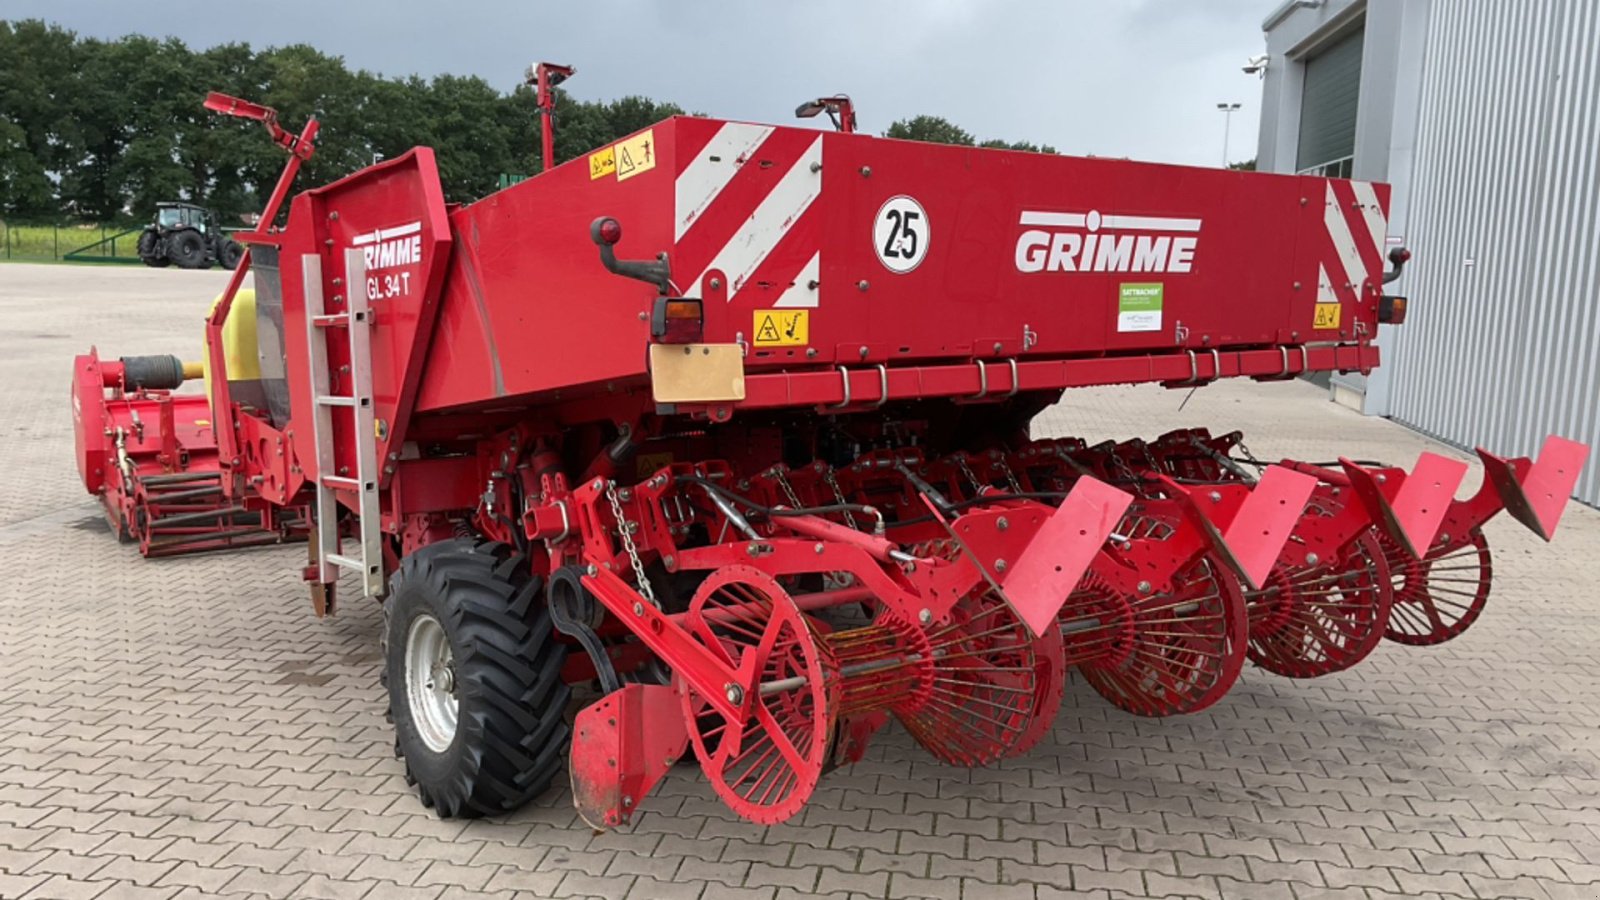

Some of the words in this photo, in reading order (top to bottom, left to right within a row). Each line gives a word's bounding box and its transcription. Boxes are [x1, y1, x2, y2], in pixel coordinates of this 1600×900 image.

[364, 228, 421, 270] RIMME
[884, 209, 919, 260] 25
[1015, 210, 1198, 273] GRIMME
[367, 277, 383, 300] GL
[384, 273, 400, 298] 34
[401, 272, 410, 295] T
